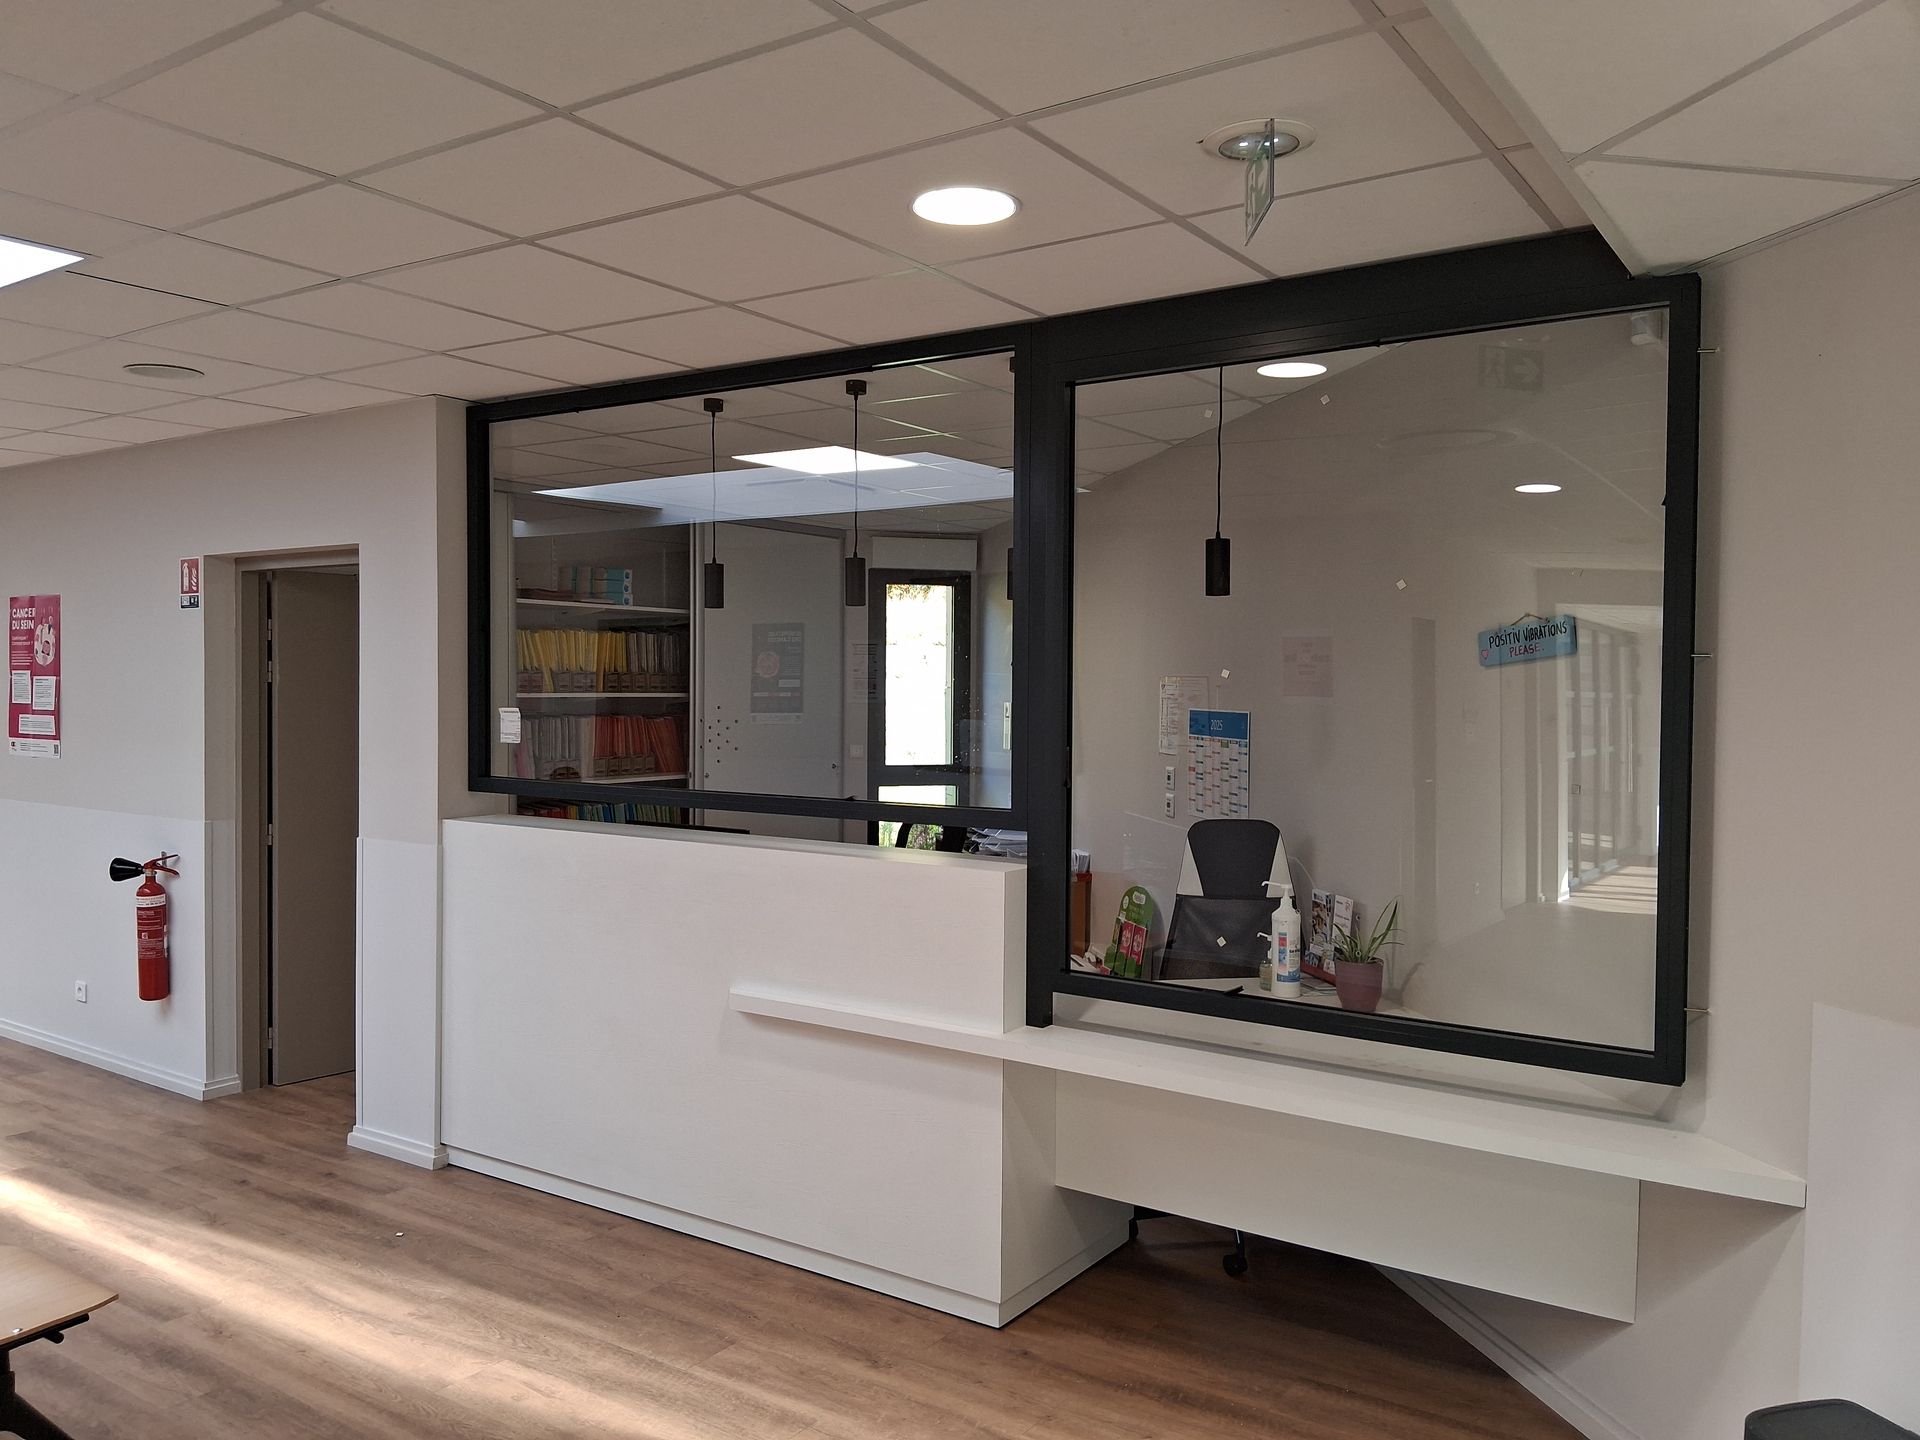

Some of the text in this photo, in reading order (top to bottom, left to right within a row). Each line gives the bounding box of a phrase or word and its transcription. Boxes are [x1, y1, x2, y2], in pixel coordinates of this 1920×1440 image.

[12, 620, 34, 630] DU SEIN
[1488, 620, 1567, 649] POSITIV VIBRATIONS
[1210, 719, 1223, 731] 2025
